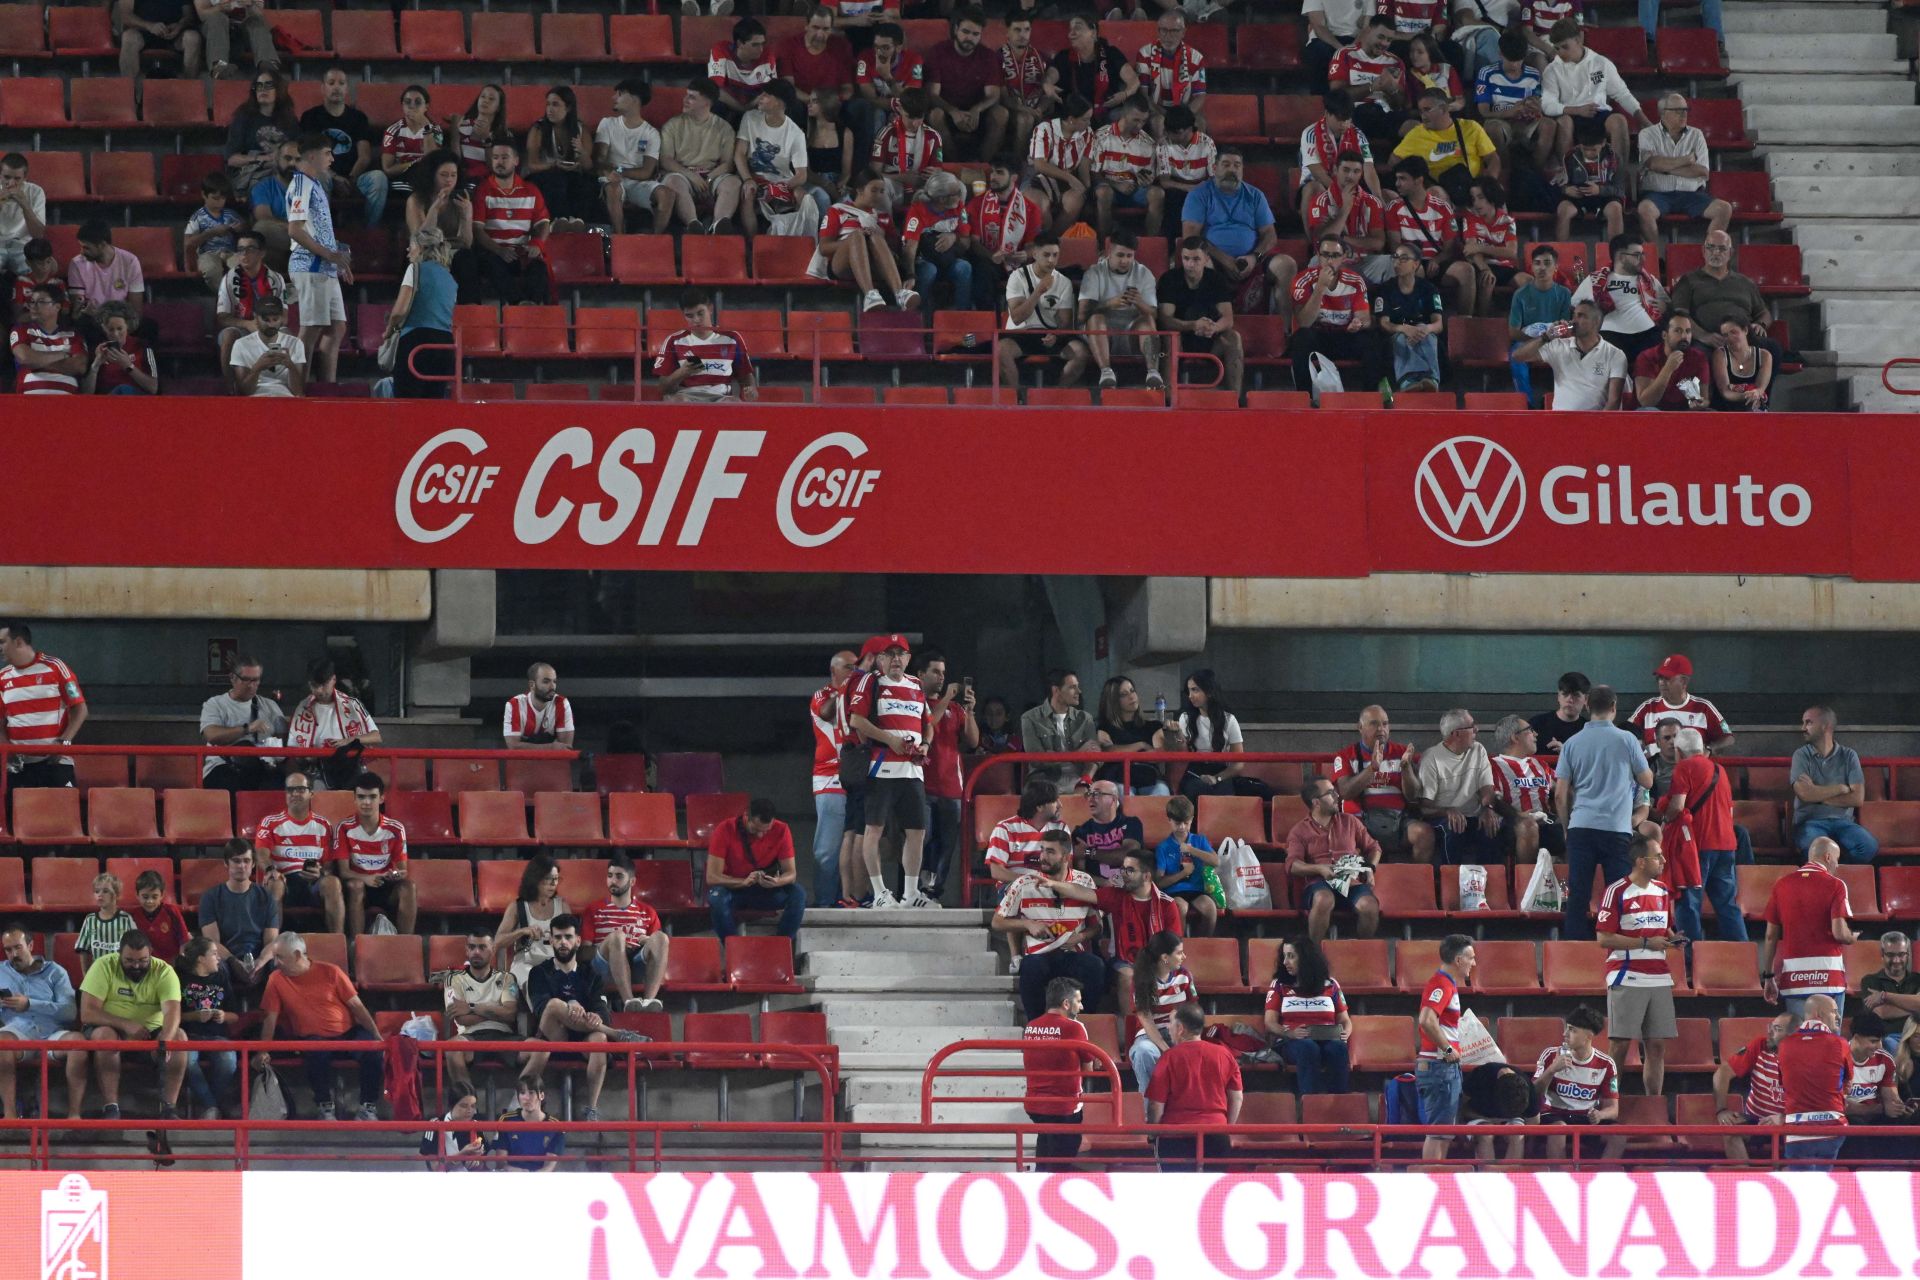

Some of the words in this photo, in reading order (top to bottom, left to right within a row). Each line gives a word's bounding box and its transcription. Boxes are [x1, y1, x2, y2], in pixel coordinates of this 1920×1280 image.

[1609, 280, 1630, 288] JUST
[416, 463, 501, 504] CSIF
[512, 426, 767, 546] CSIF
[797, 467, 881, 508] CSIF
[1539, 463, 1812, 527] Gilauto
[1790, 971, 1829, 983] Greening
[1556, 1082, 1596, 1100] wiber
